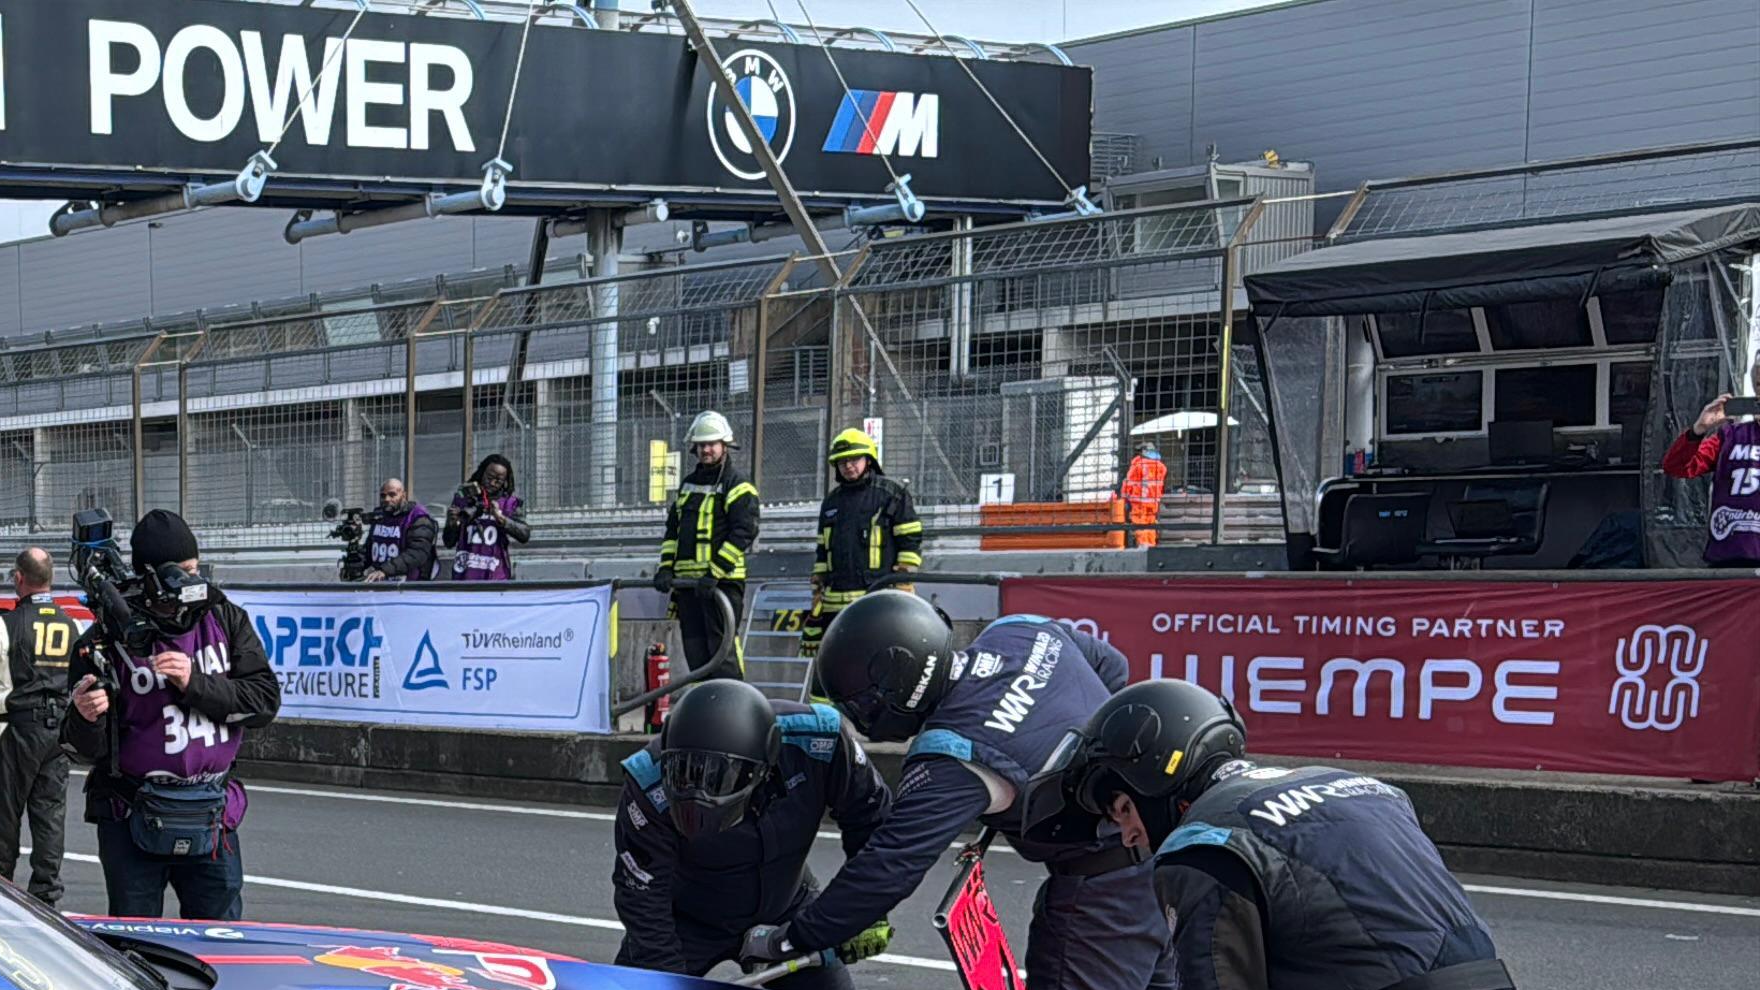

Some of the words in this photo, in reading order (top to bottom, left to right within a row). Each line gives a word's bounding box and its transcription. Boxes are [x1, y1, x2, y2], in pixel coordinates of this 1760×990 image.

[89, 19, 477, 152] POWER
[992, 477, 1003, 499] 1
[773, 609, 803, 632] 75
[1152, 613, 1281, 634] OFFICIAL
[1294, 615, 1396, 636] TIMING
[1412, 618, 1565, 638] PARTNER
[33, 622, 70, 657] 10
[256, 615, 383, 667] SPEICH
[462, 667, 497, 691] FSP
[906, 655, 938, 709] BERKAN
[1150, 653, 1560, 725] WEMPE
